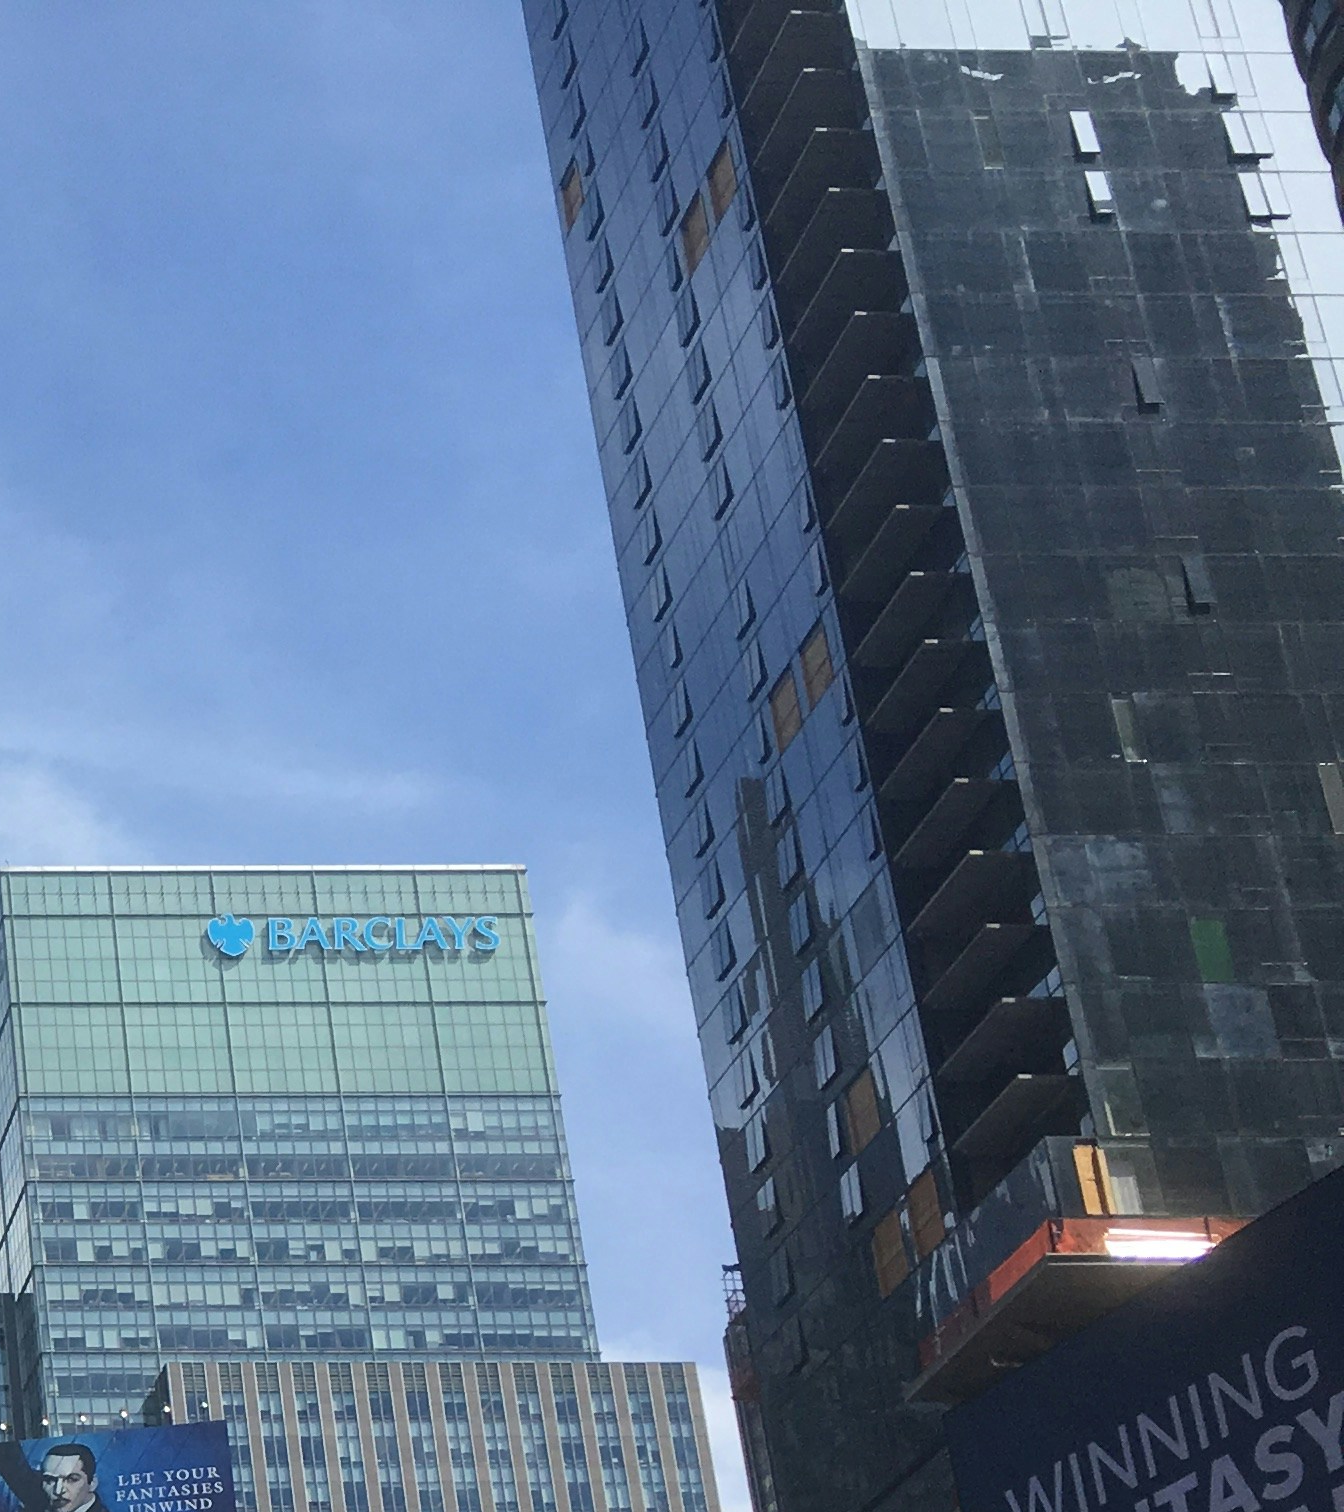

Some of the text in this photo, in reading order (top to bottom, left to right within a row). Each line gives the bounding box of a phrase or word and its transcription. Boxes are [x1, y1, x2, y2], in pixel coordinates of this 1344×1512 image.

[268, 916, 501, 951] BARCLAYS
[117, 1465, 221, 1487] LET YOUR
[115, 1480, 225, 1503] FANTASIES
